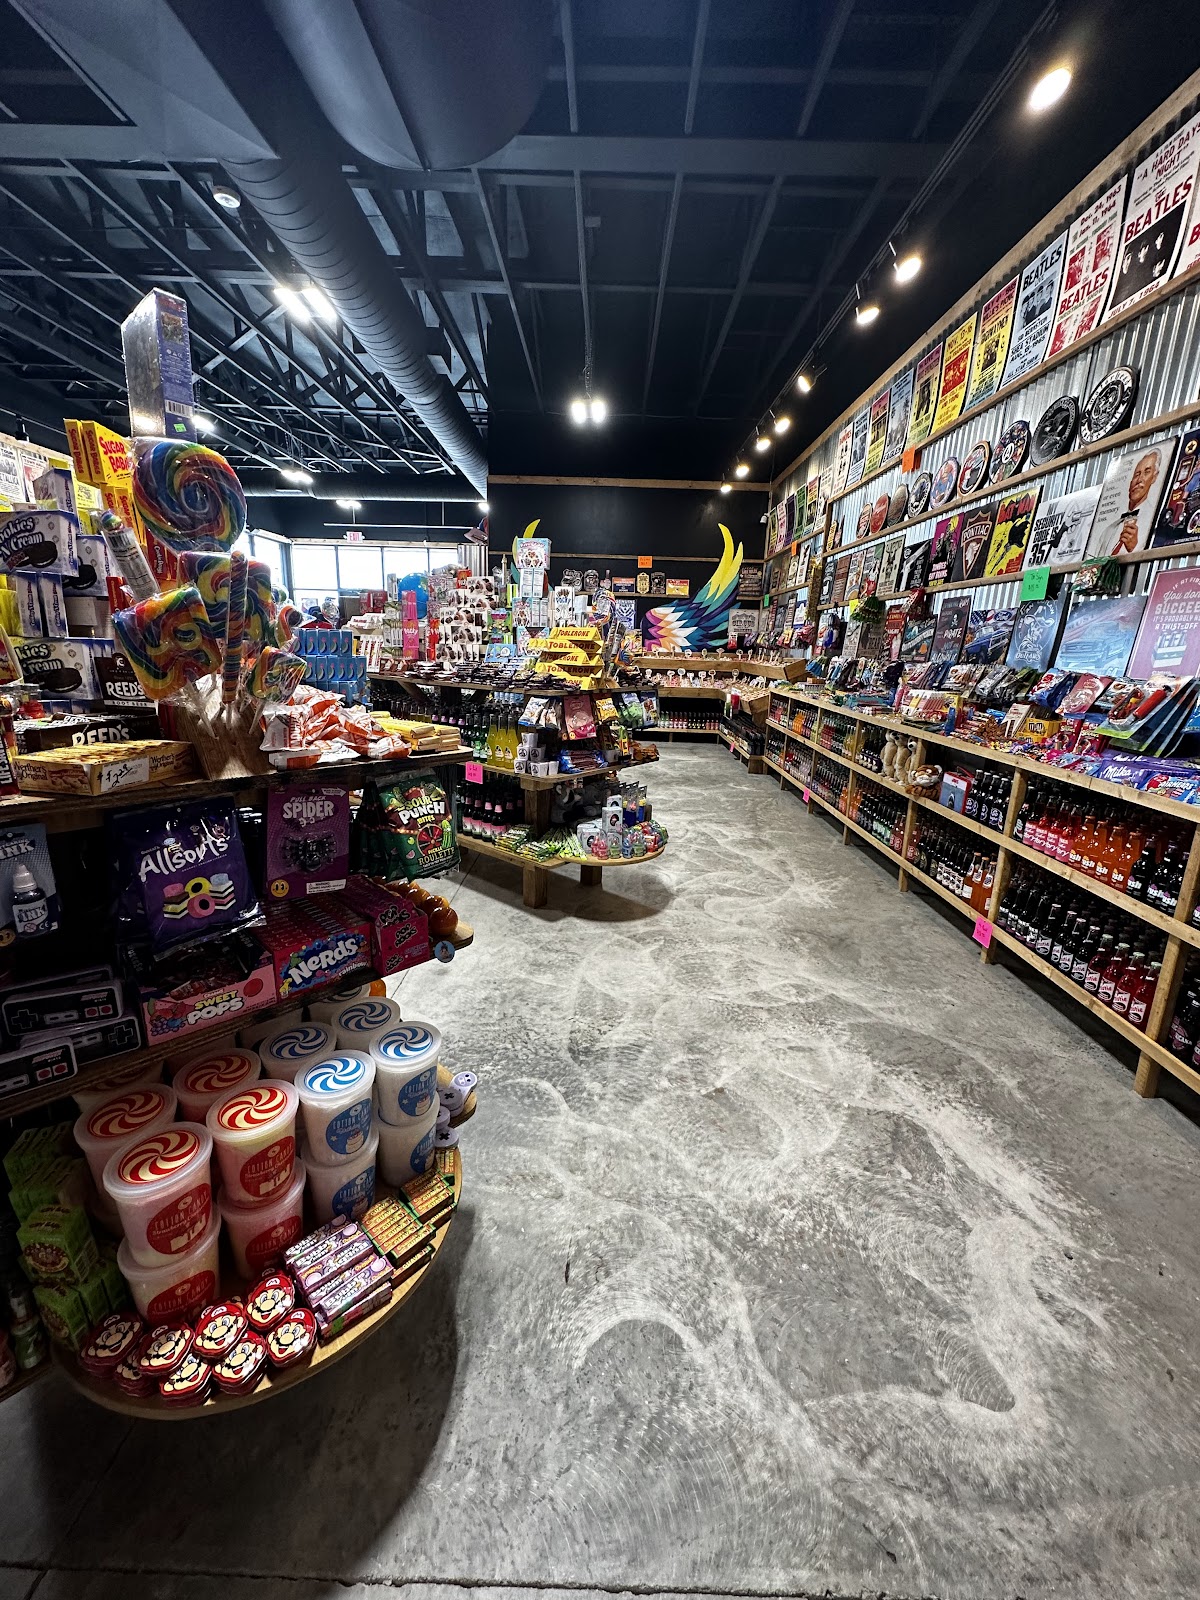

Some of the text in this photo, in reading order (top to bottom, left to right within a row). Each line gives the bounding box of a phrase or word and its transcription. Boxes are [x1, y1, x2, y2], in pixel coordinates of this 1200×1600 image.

[1151, 145, 1175, 173] HARD
[1124, 174, 1193, 245] BEATLES
[1022, 244, 1063, 292] BEATLES
[1058, 267, 1109, 316] BEATLES
[1025, 323, 1050, 347] STADIUM
[68, 428, 79, 450] SUGAR
[85, 428, 95, 450] SUGAR
[99, 436, 126, 455] SUGAR
[74, 451, 84, 474] BABIES
[90, 452, 101, 475] BABIES
[1109, 491, 1121, 499] even
[1100, 507, 1120, 515] memory
[1034, 512, 1065, 531] SECURITY
[0, 517, 43, 551] ookies Cream
[349, 533, 361, 541] EXIT
[963, 525, 990, 540] PONTIAC
[1033, 526, 1059, 544] CODE IS
[1028, 543, 1052, 567] 357
[1184, 590, 1200, 599] don
[1155, 601, 1200, 615] SUCCEE
[14, 643, 48, 659] kies
[549, 641, 595, 650] TOBLERONE
[547, 666, 594, 674] TOBLERONE
[106, 682, 144, 697] REED'S
[150, 753, 175, 764] Werther's
[22, 770, 48, 780] Original
[1102, 766, 1132, 778] Milka
[283, 801, 335, 819] SPIDER
[404, 796, 432, 810] SOUR
[399, 802, 445, 825] PUNCH
[417, 815, 435, 825] BITES
[138, 836, 229, 882] Allsorts
[418, 847, 455, 866] ROULETTE
[395, 923, 411, 938] POP
[338, 961, 368, 977] rainbow
[195, 990, 237, 1009] SWEET
[187, 998, 243, 1025] POPS
[332, 1116, 352, 1129] COTTON
[247, 1160, 272, 1174] COTTON
[154, 1190, 210, 1231] COTTON CANDY
